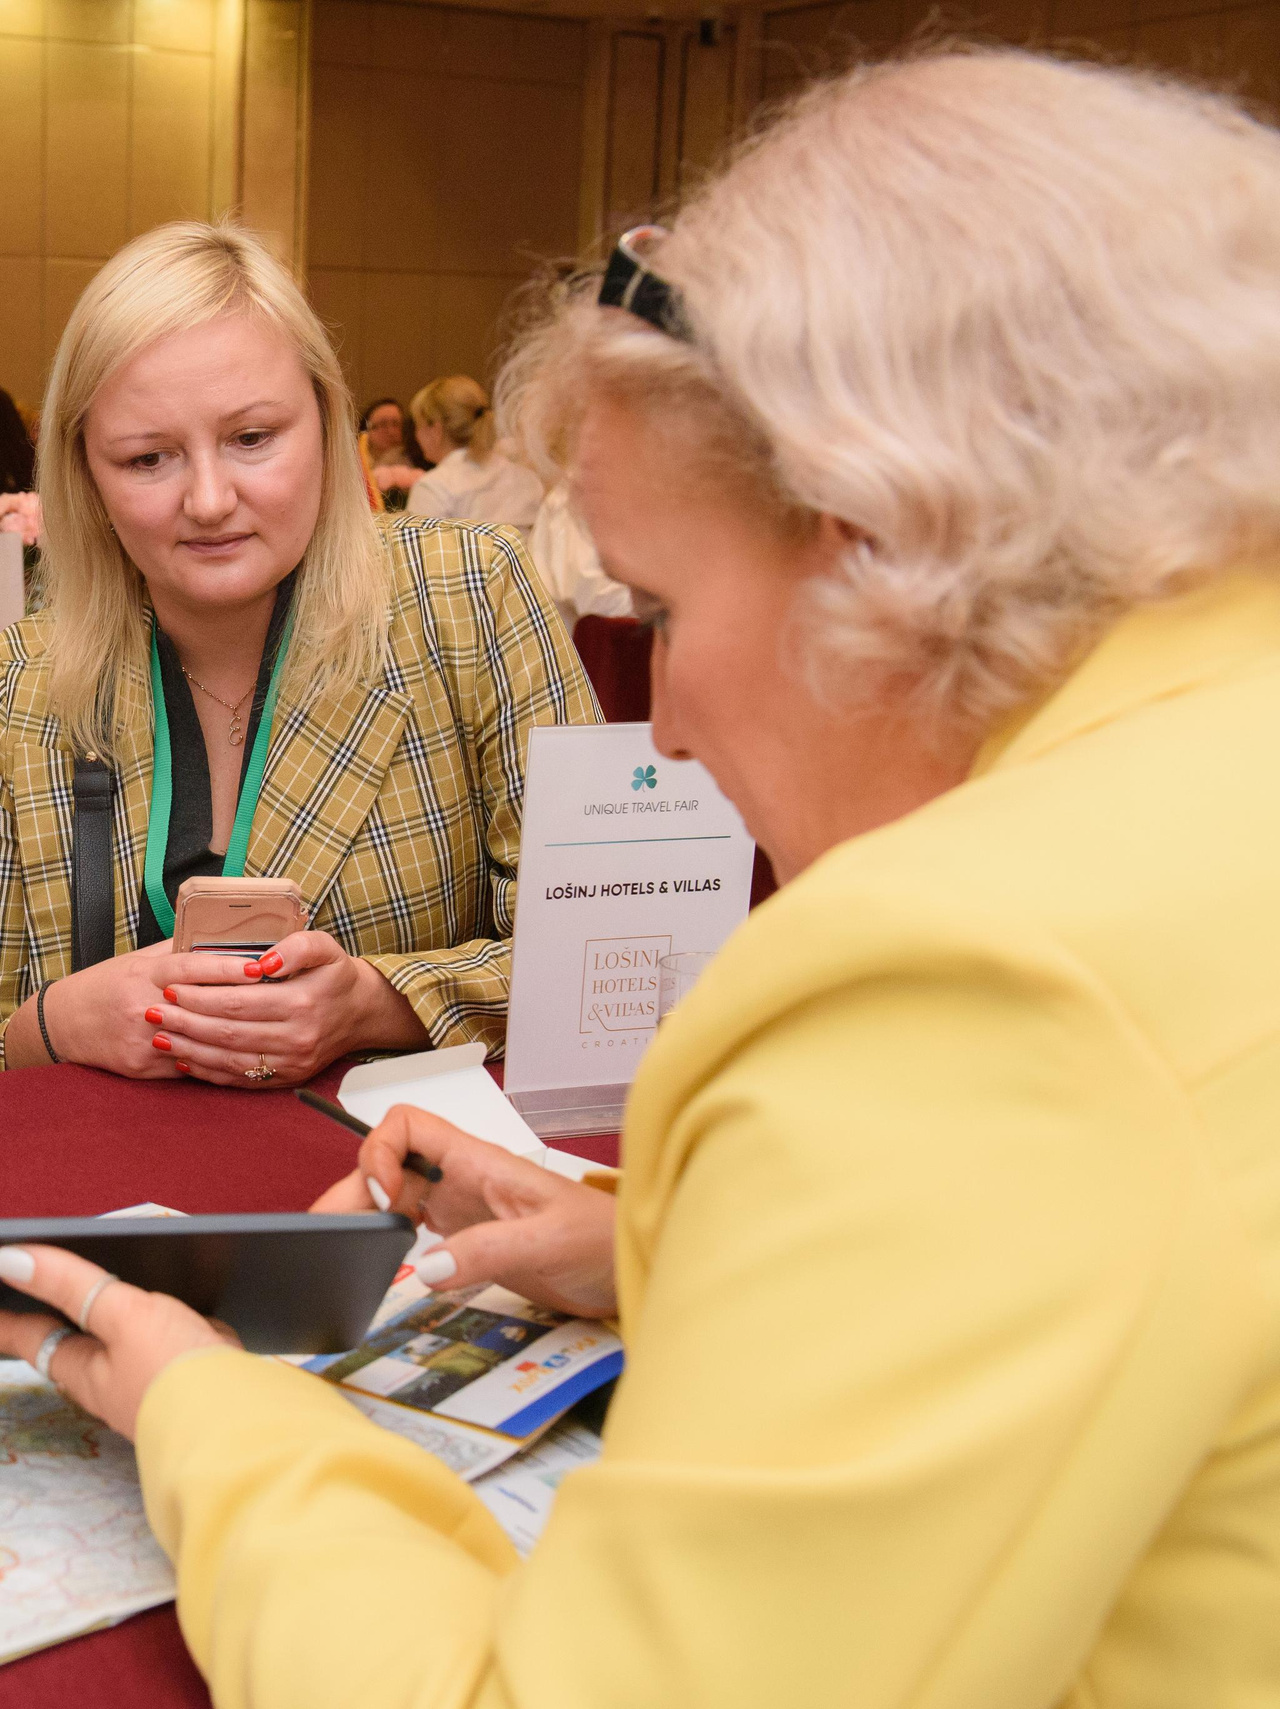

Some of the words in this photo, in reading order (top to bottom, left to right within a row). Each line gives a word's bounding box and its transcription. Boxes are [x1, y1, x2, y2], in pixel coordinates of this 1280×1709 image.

[584, 803, 629, 816] UNIQUE
[632, 801, 671, 813] TRAVEL
[674, 800, 699, 811] FAIR
[546, 883, 596, 900] LOŠINJ
[601, 882, 654, 897] HOTELS
[659, 881, 668, 893] &
[673, 878, 721, 893] VILLAS
[594, 946, 660, 970] LOŠINJ
[592, 976, 657, 994] HOTELS
[582, 1037, 648, 1049] CROATI
